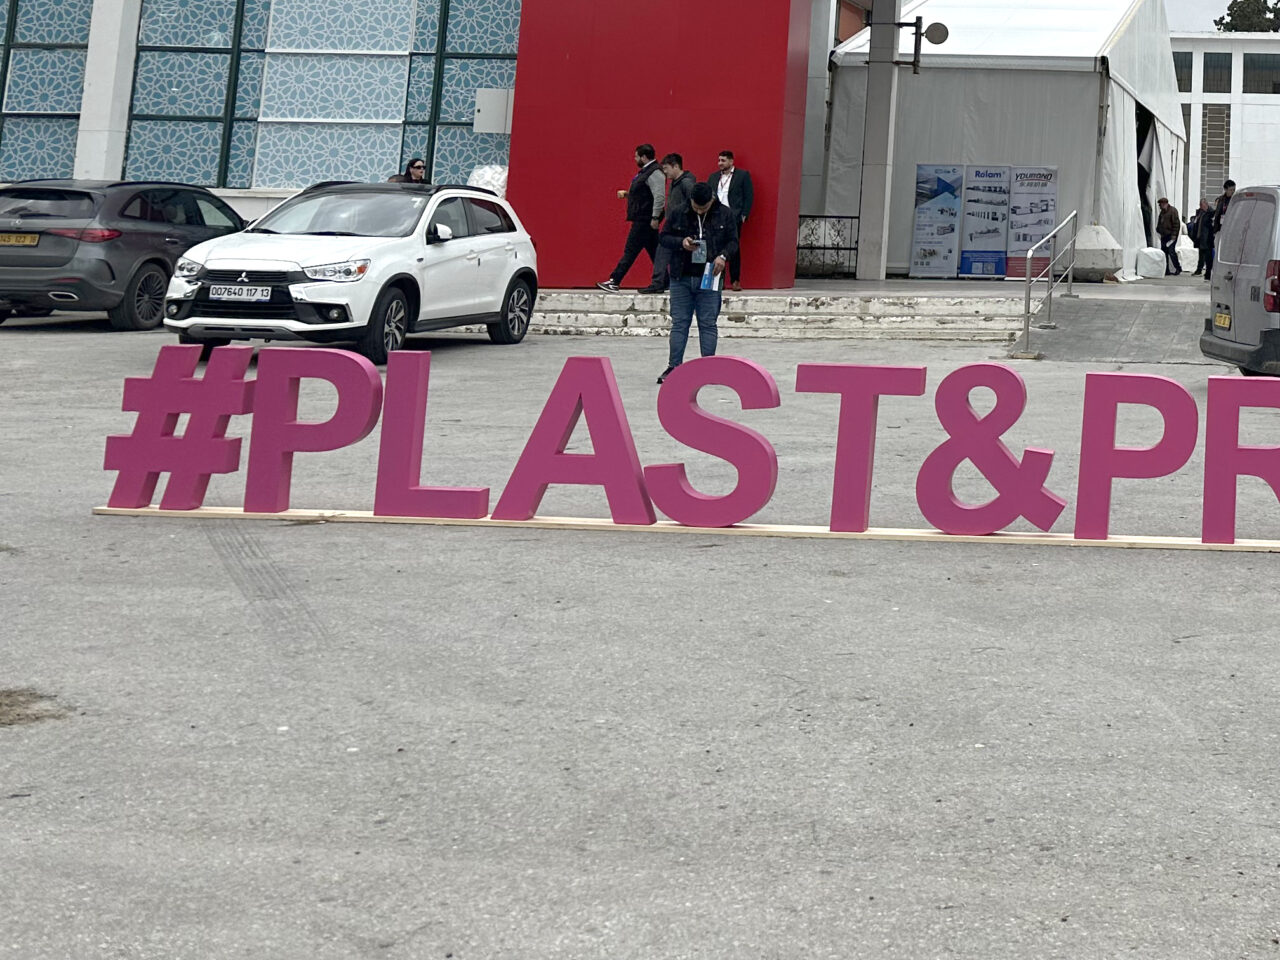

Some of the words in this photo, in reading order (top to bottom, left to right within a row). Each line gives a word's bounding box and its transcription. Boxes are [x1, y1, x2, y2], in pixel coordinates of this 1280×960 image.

[211, 286, 244, 297] 007640
[246, 287, 258, 297] 117
[260, 288, 270, 298] 13
